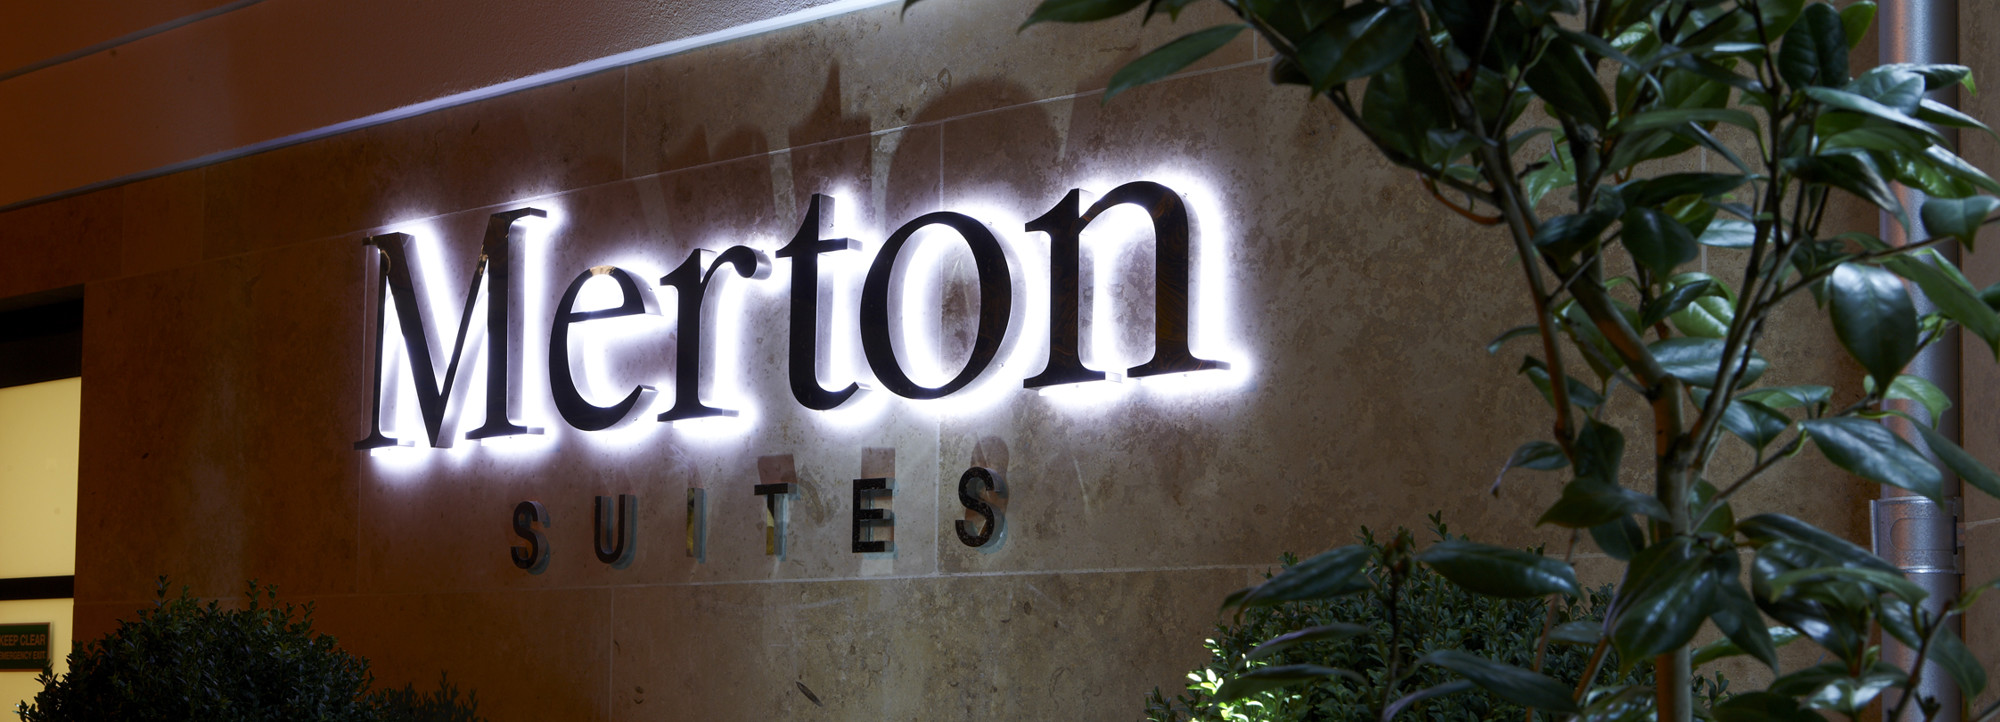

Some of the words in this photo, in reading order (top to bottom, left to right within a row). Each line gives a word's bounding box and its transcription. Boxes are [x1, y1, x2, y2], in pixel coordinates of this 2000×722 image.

[354, 179, 1231, 451] Merton
[510, 466, 1006, 570] SUITES
[0, 634, 19, 646] KEEP
[20, 633, 46, 646] CLEAR
